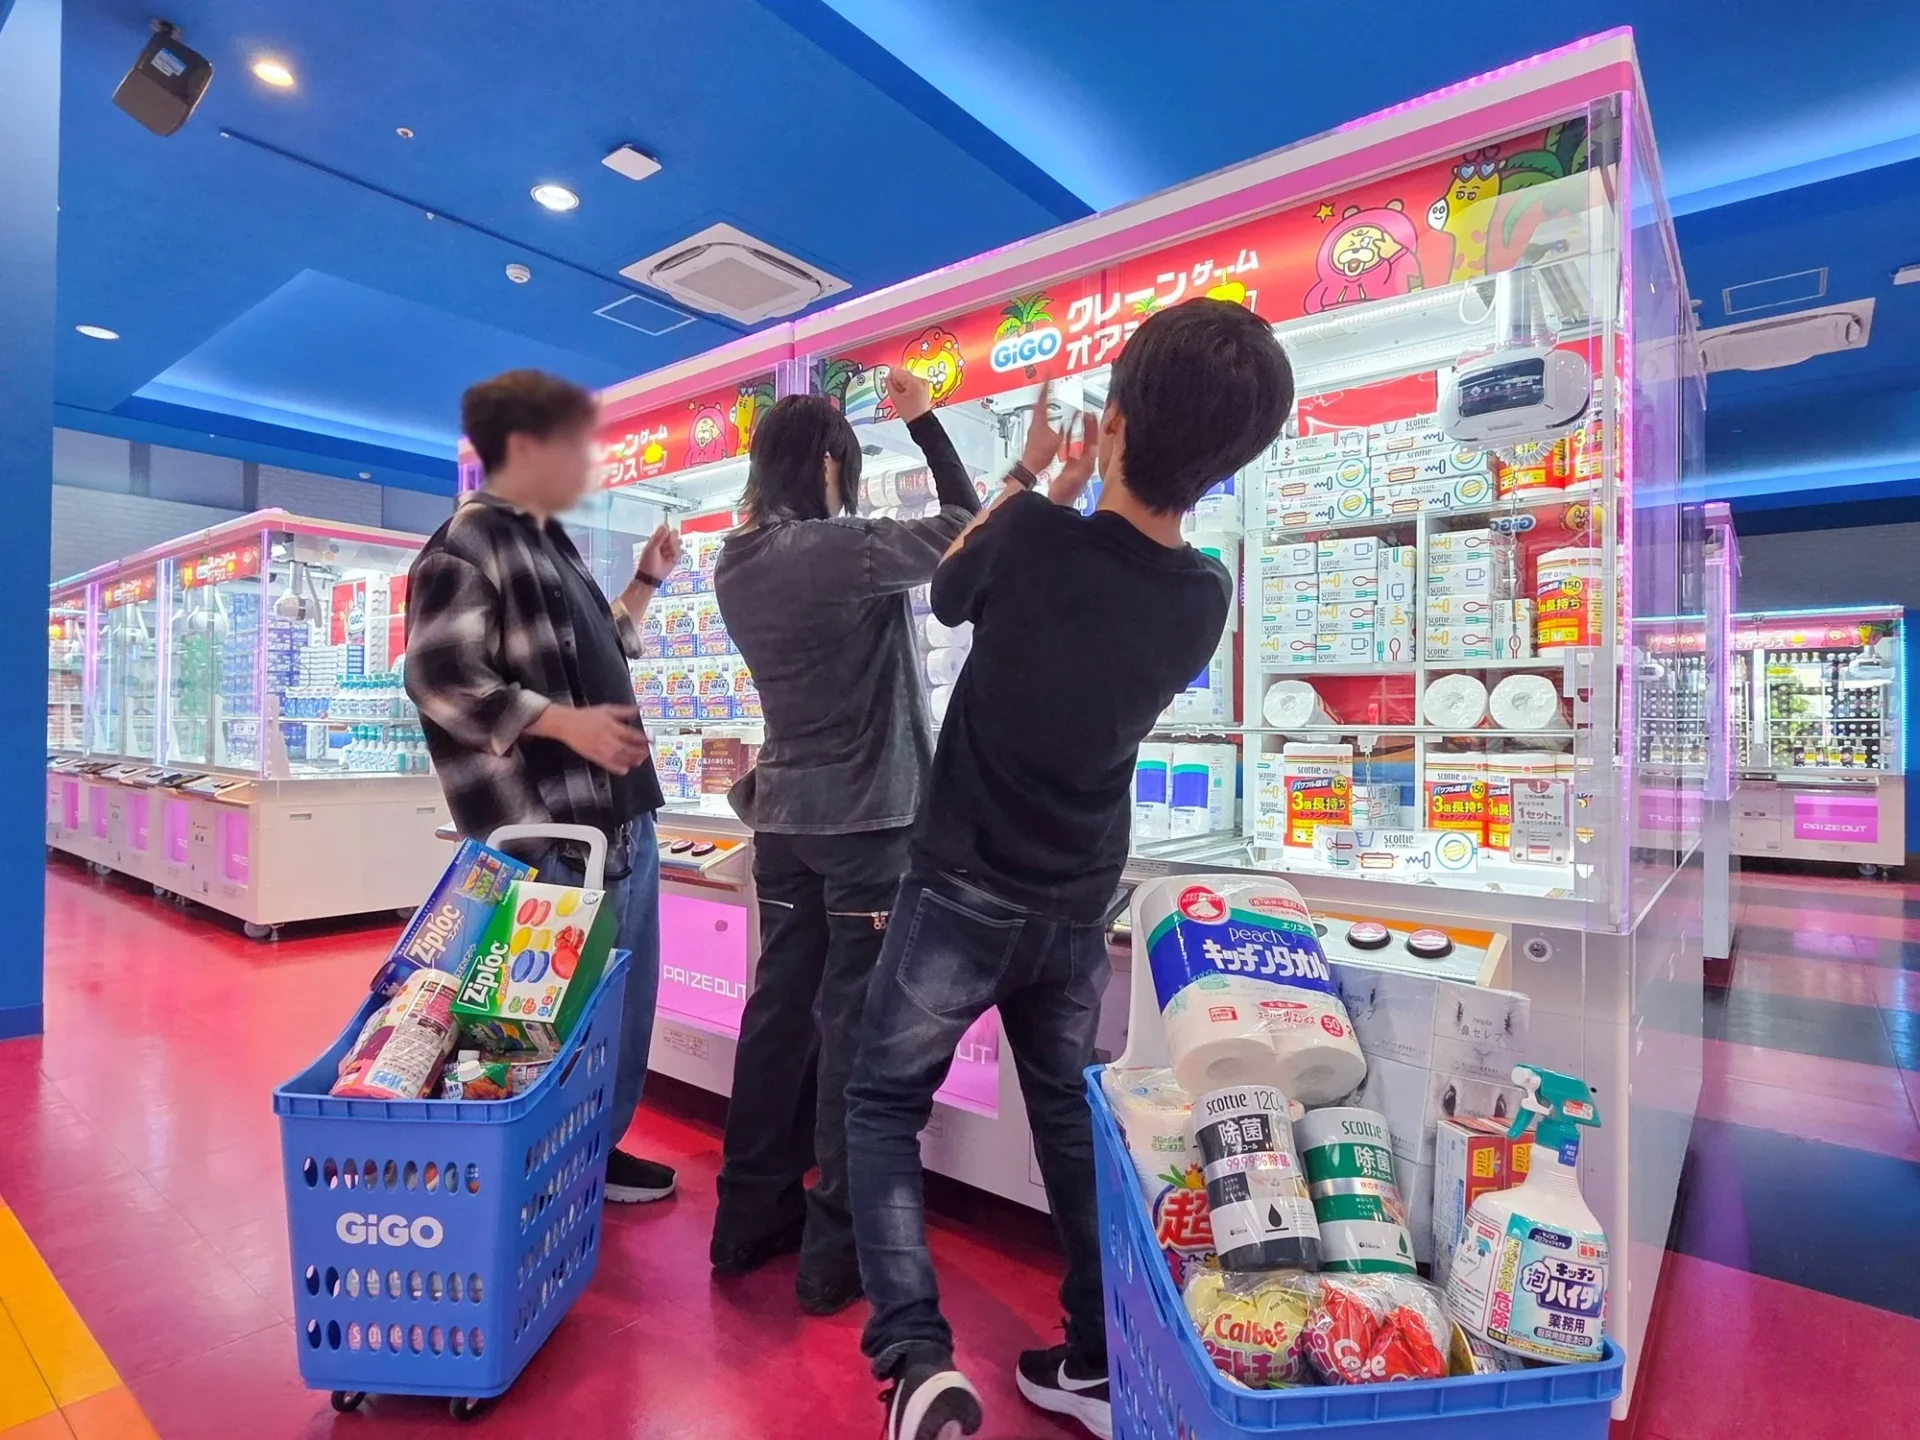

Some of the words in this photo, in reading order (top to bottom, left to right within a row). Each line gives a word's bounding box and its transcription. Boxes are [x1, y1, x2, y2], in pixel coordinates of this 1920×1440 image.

[993, 332, 1058, 369] GiGO
[1564, 581, 1580, 589] 150
[1427, 648, 1449, 656] scottie
[1297, 766, 1321, 774] scottie
[1333, 780, 1346, 788] 150
[1471, 785, 1483, 793] 150
[1291, 791, 1346, 810] 3倍長持ち
[1432, 795, 1484, 813] 3倍長持ち
[1803, 822, 1868, 833] PRIZEOUT
[1384, 834, 1414, 843] scottie
[410, 905, 460, 965] Ziploc
[1228, 927, 1291, 946] peach
[1203, 938, 1329, 982] キッチンタオル
[463, 942, 509, 1004] Ziploc
[663, 965, 746, 1002] PRIZEOUT
[1323, 1017, 1341, 1031] 50
[1206, 1093, 1249, 1115] scottie
[1217, 1118, 1263, 1146] 除菌
[1341, 1121, 1382, 1139] scottie
[1354, 1146, 1390, 1173] 除菌
[336, 1212, 444, 1248] GiGO
[1526, 1268, 1546, 1288] 泡
[1556, 1263, 1595, 1281] キッチン
[1490, 1291, 1511, 1332] 危険
[1214, 1313, 1288, 1348] Calbee
[1548, 1313, 1585, 1333] 業務用
